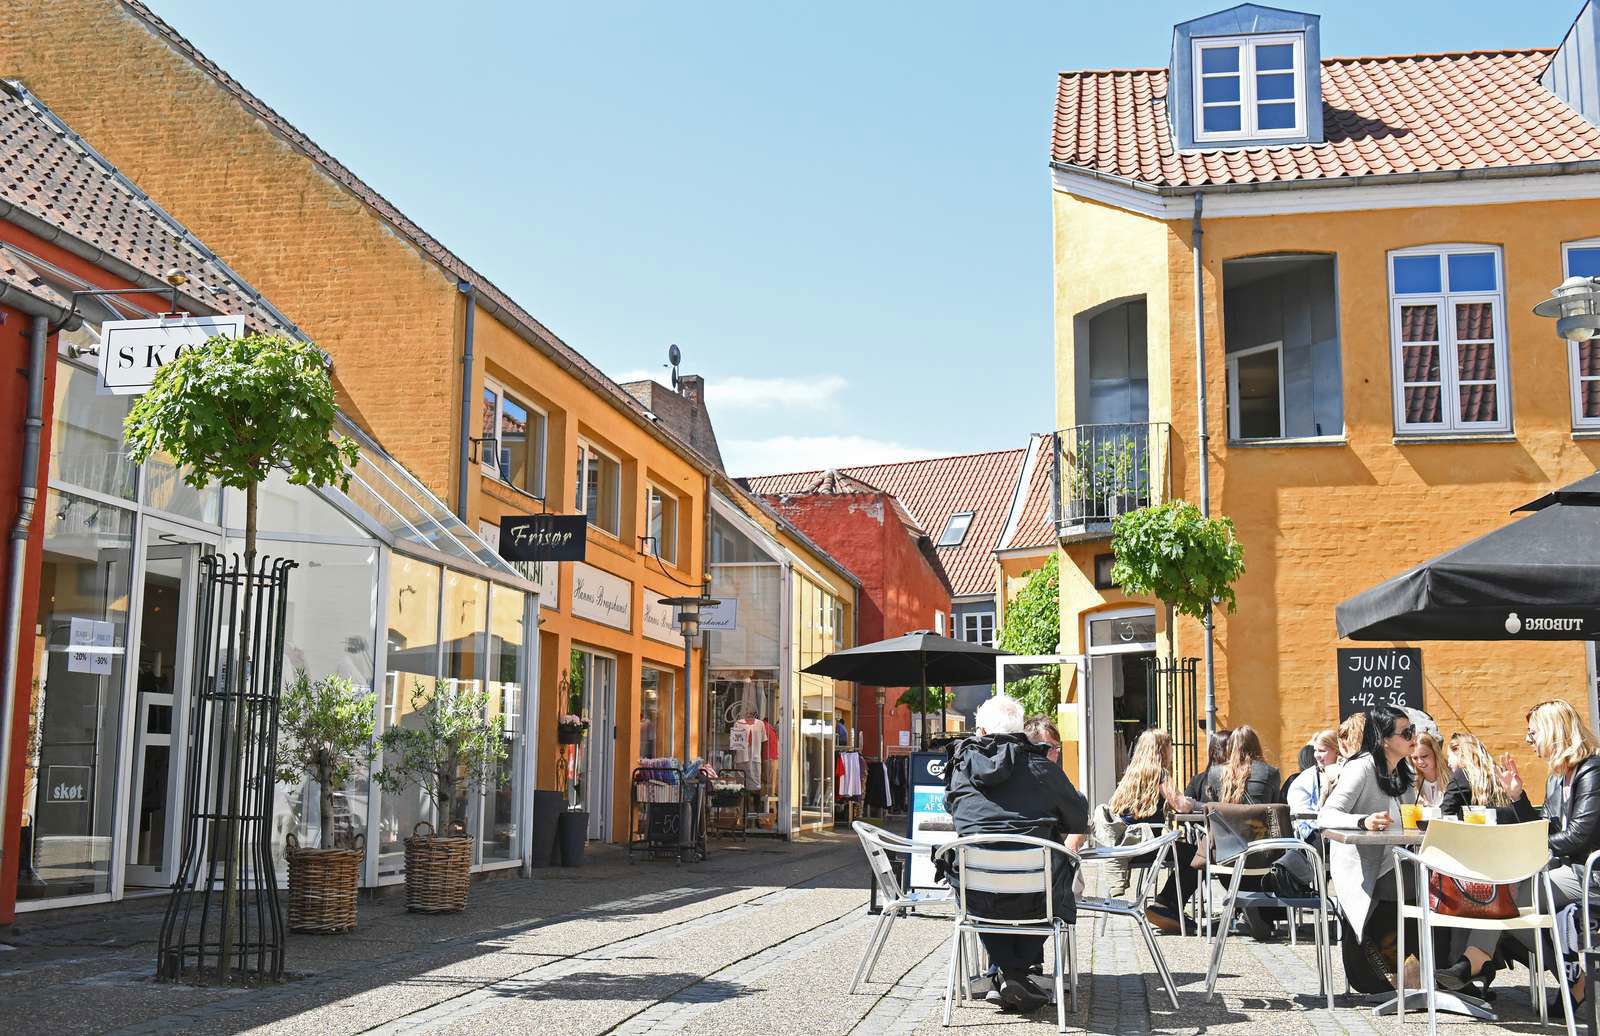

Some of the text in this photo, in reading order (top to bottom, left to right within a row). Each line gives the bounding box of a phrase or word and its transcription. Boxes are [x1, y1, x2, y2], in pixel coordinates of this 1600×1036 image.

[511, 525, 572, 547] Frisør
[1120, 622, 1135, 641] 3
[1362, 676, 1404, 688] MODE
[53, 782, 83, 800] skøt
